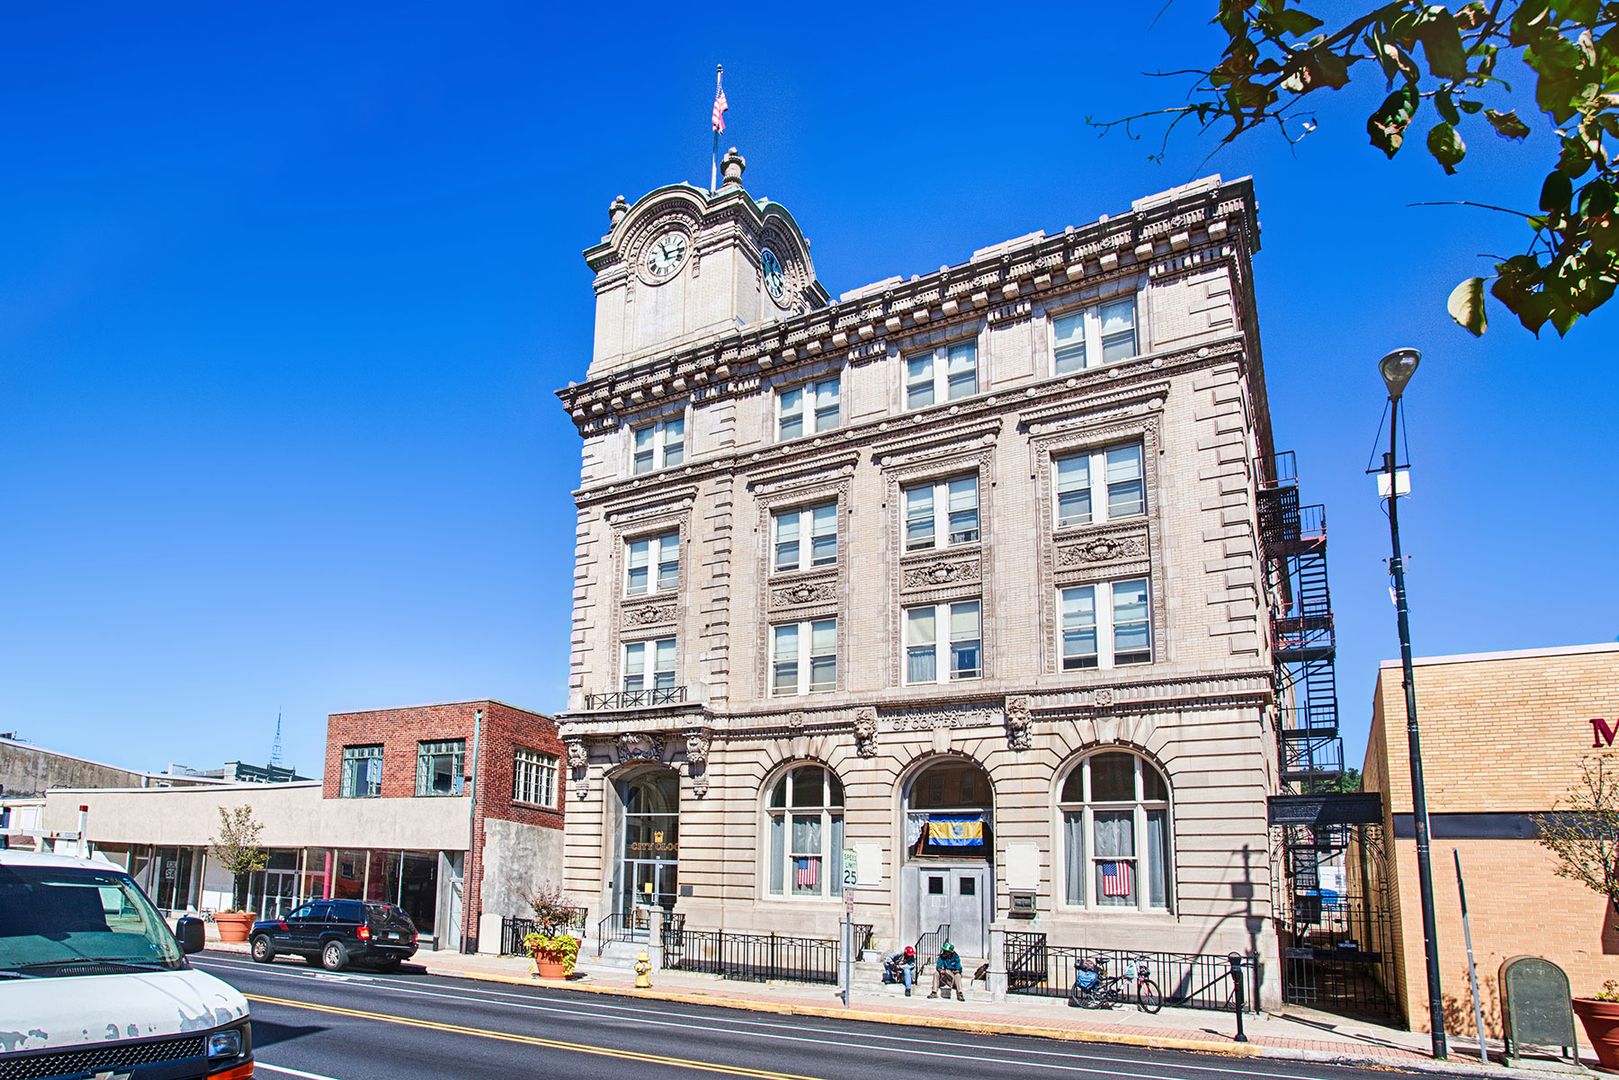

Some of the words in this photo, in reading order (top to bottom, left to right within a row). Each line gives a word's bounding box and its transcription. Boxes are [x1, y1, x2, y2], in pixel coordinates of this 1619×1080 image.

[904, 706, 966, 720] NATIONAL
[892, 720, 908, 731] OF
[911, 714, 991, 730] COATESVILLE
[630, 842, 655, 851] CITY
[844, 869, 857, 885] 25
